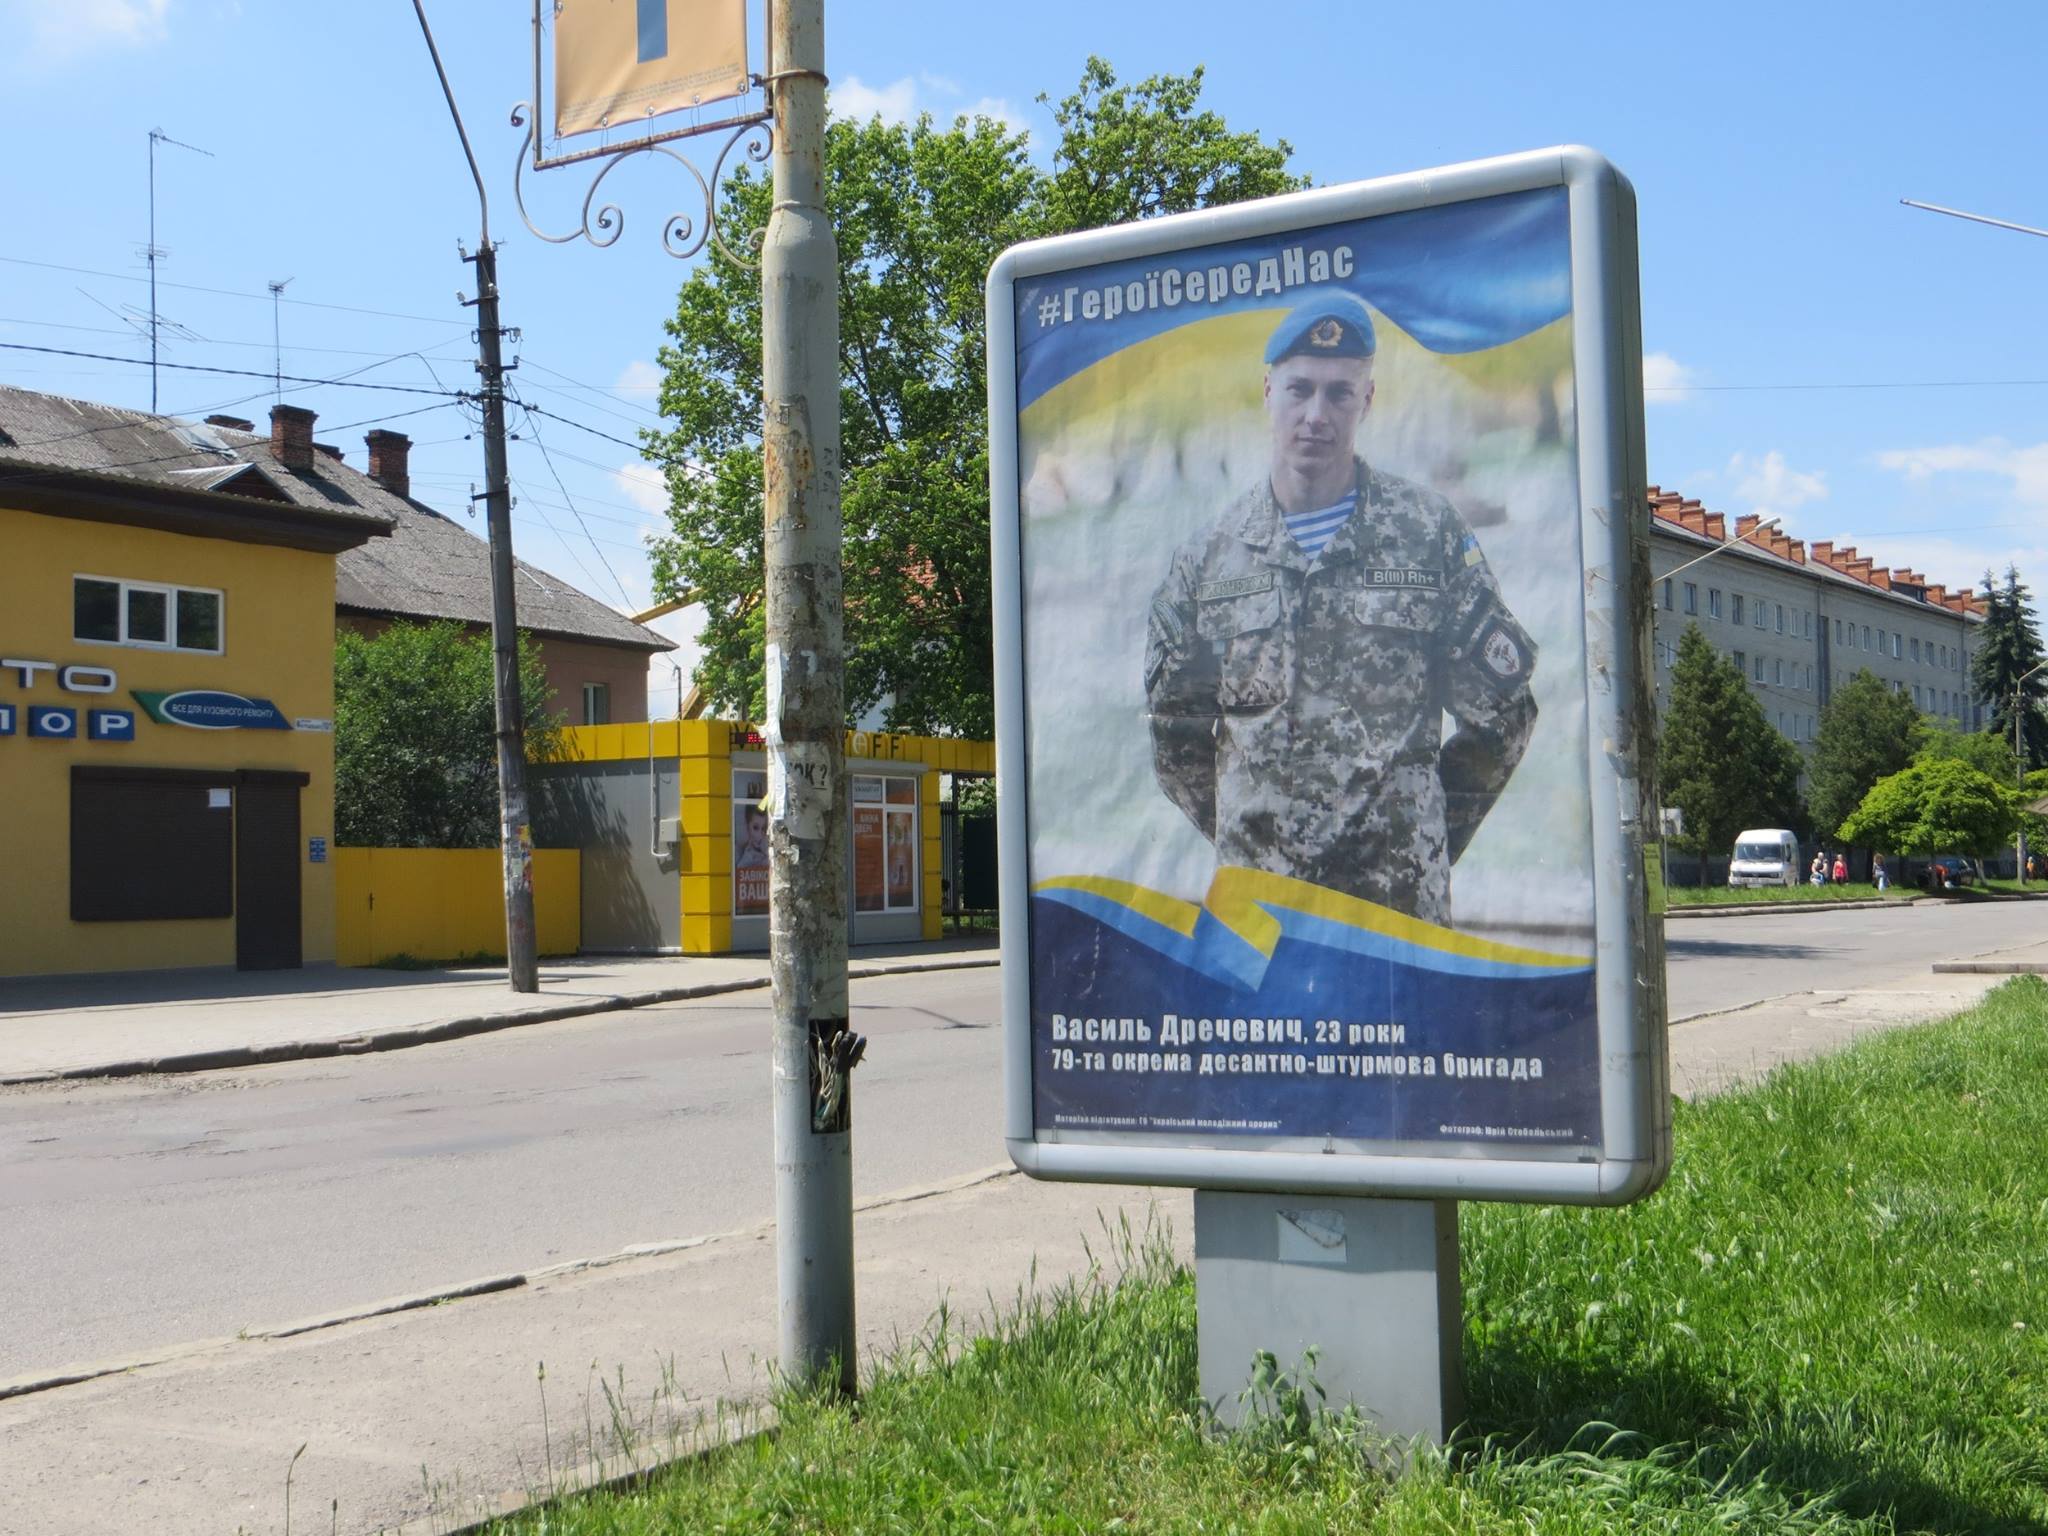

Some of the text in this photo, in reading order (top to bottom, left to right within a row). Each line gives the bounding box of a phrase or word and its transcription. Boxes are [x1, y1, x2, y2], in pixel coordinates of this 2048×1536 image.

[1038, 246, 1353, 327] #ГероїСередНас
[1374, 570, 1435, 584] B(III) Rh+
[172, 704, 187, 713] ВСЕ
[187, 705, 202, 714] ДЛЯ
[1052, 1014, 1405, 1046] Василь Дречевич, 23 роки
[1052, 1048, 1543, 1080] 79-та окрема десантно-штурмова бригада
